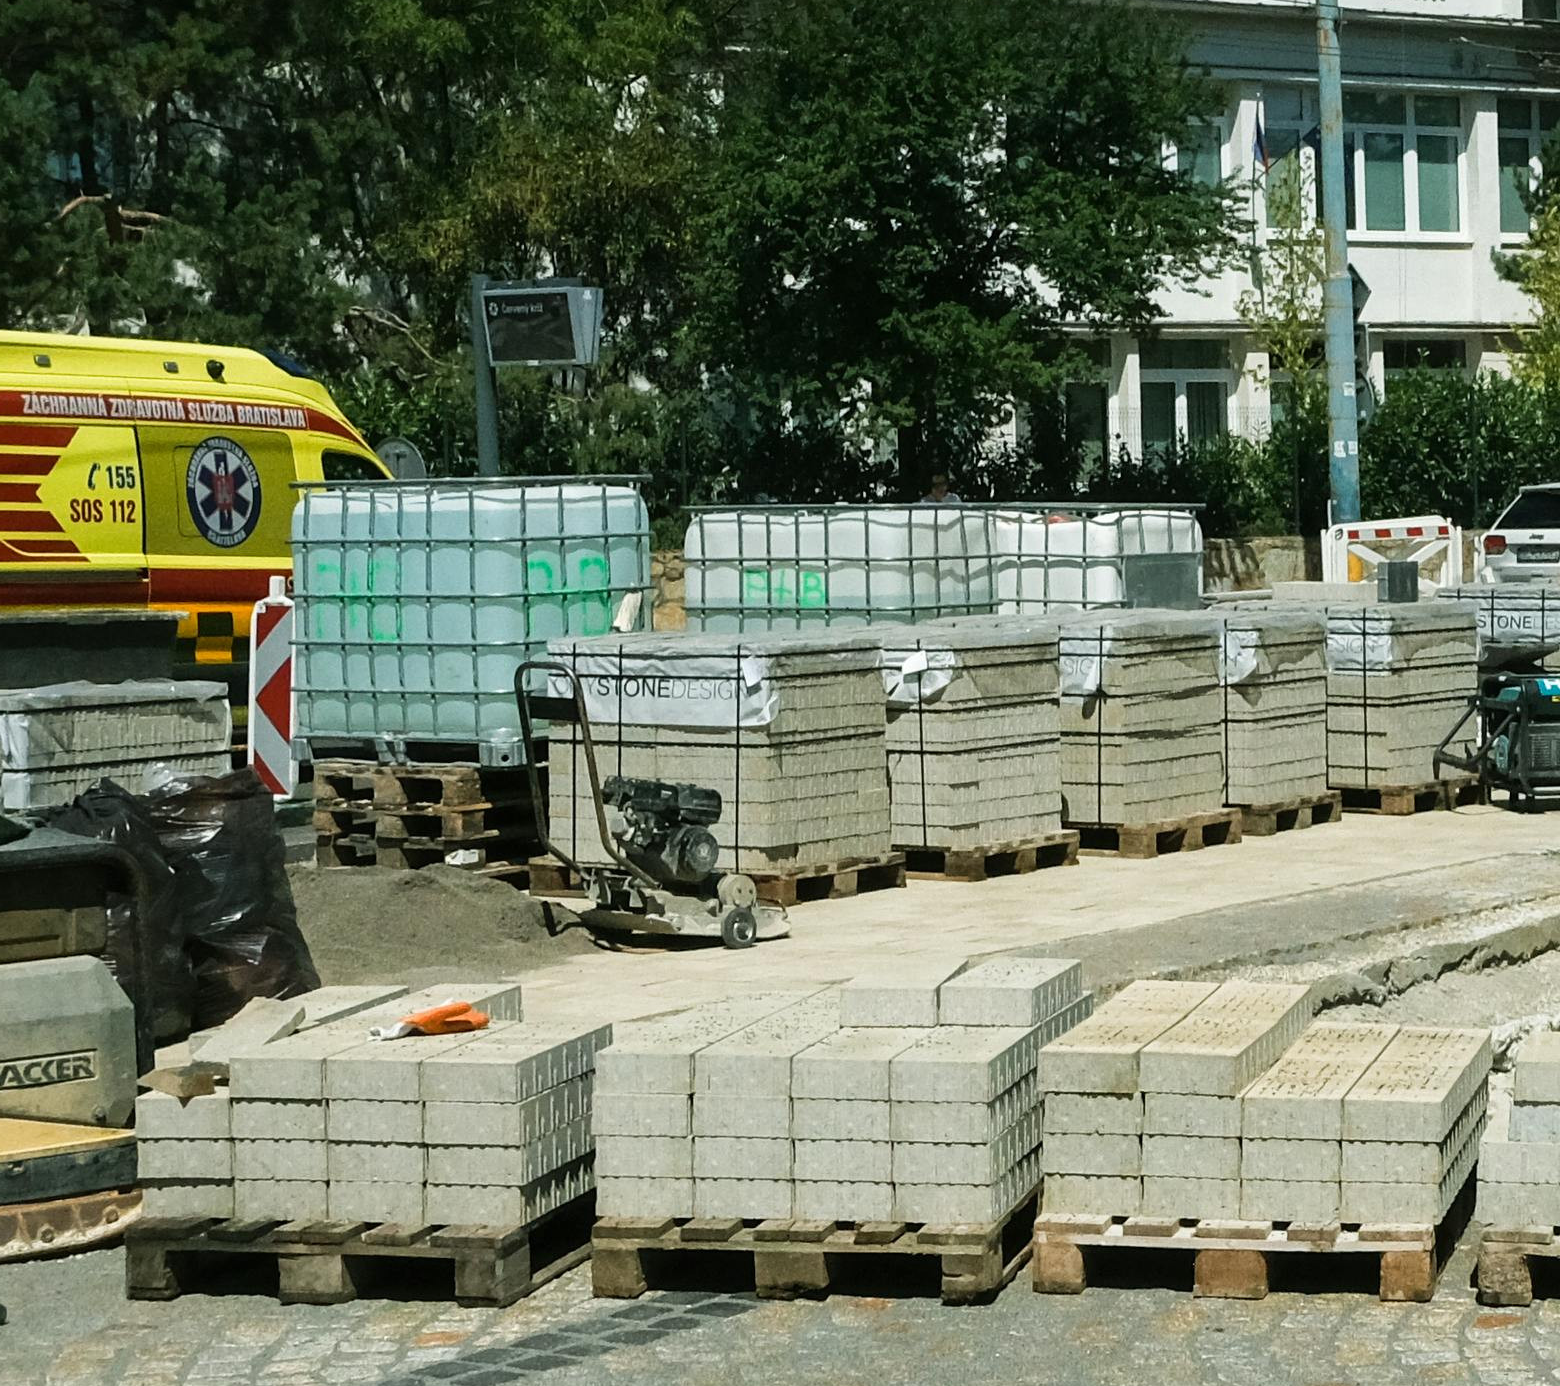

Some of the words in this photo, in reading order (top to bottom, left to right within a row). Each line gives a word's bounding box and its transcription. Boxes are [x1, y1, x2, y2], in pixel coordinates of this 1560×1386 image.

[21, 391, 107, 417] ZÁCHRANNÁ
[108, 397, 185, 421] ZDRAVOTNÁ
[187, 401, 235, 423] SLUŽBA
[238, 405, 307, 428] BRATISLAVA
[105, 465, 136, 490] 155
[69, 498, 104, 524] SOS
[109, 499, 137, 524] 112
